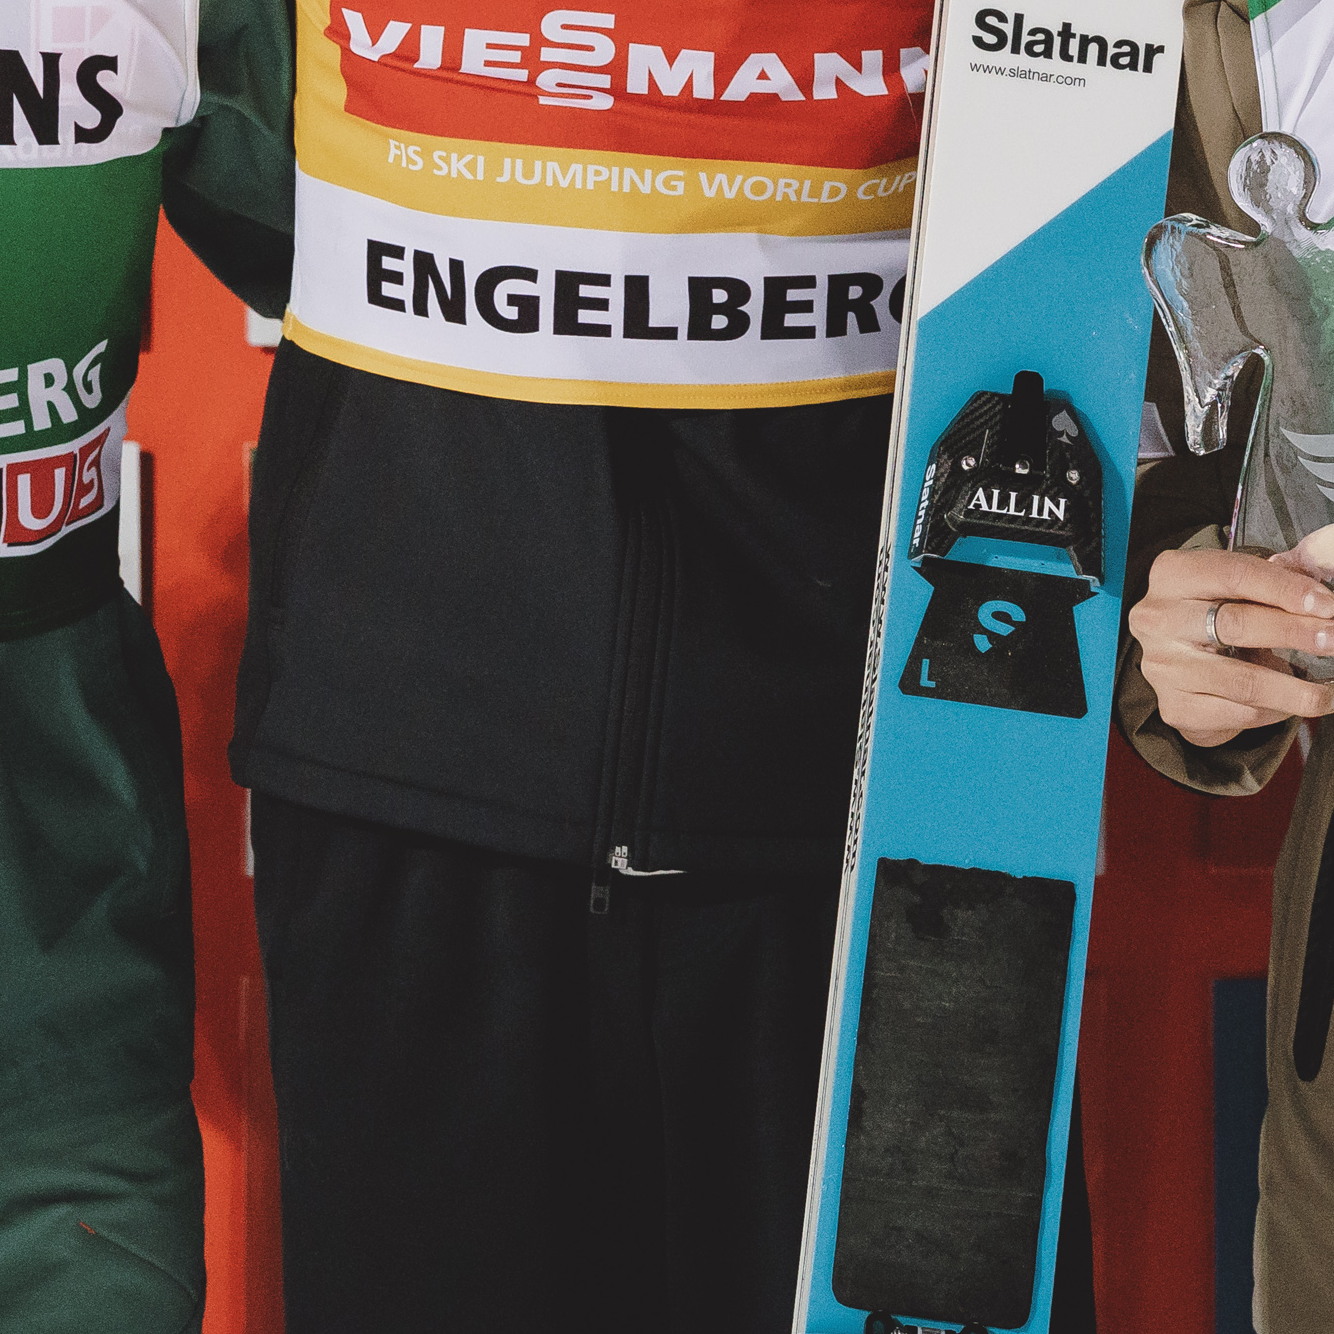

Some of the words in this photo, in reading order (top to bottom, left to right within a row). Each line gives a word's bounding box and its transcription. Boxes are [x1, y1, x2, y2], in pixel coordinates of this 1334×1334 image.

[971, 7, 1166, 74] Slatnar
[969, 61, 1087, 88] www.slatnar.com
[386, 139, 423, 170] FIS
[433, 151, 486, 181] SKI
[496, 157, 687, 198] JUMPING
[697, 172, 848, 204] WORLD
[856, 170, 917, 201] CUP
[365, 238, 906, 344] ENGELBER
[911, 463, 937, 549] Slatnar
[967, 486, 1026, 517] ALL
[1028, 494, 1067, 522] IN
[919, 658, 936, 688] L
